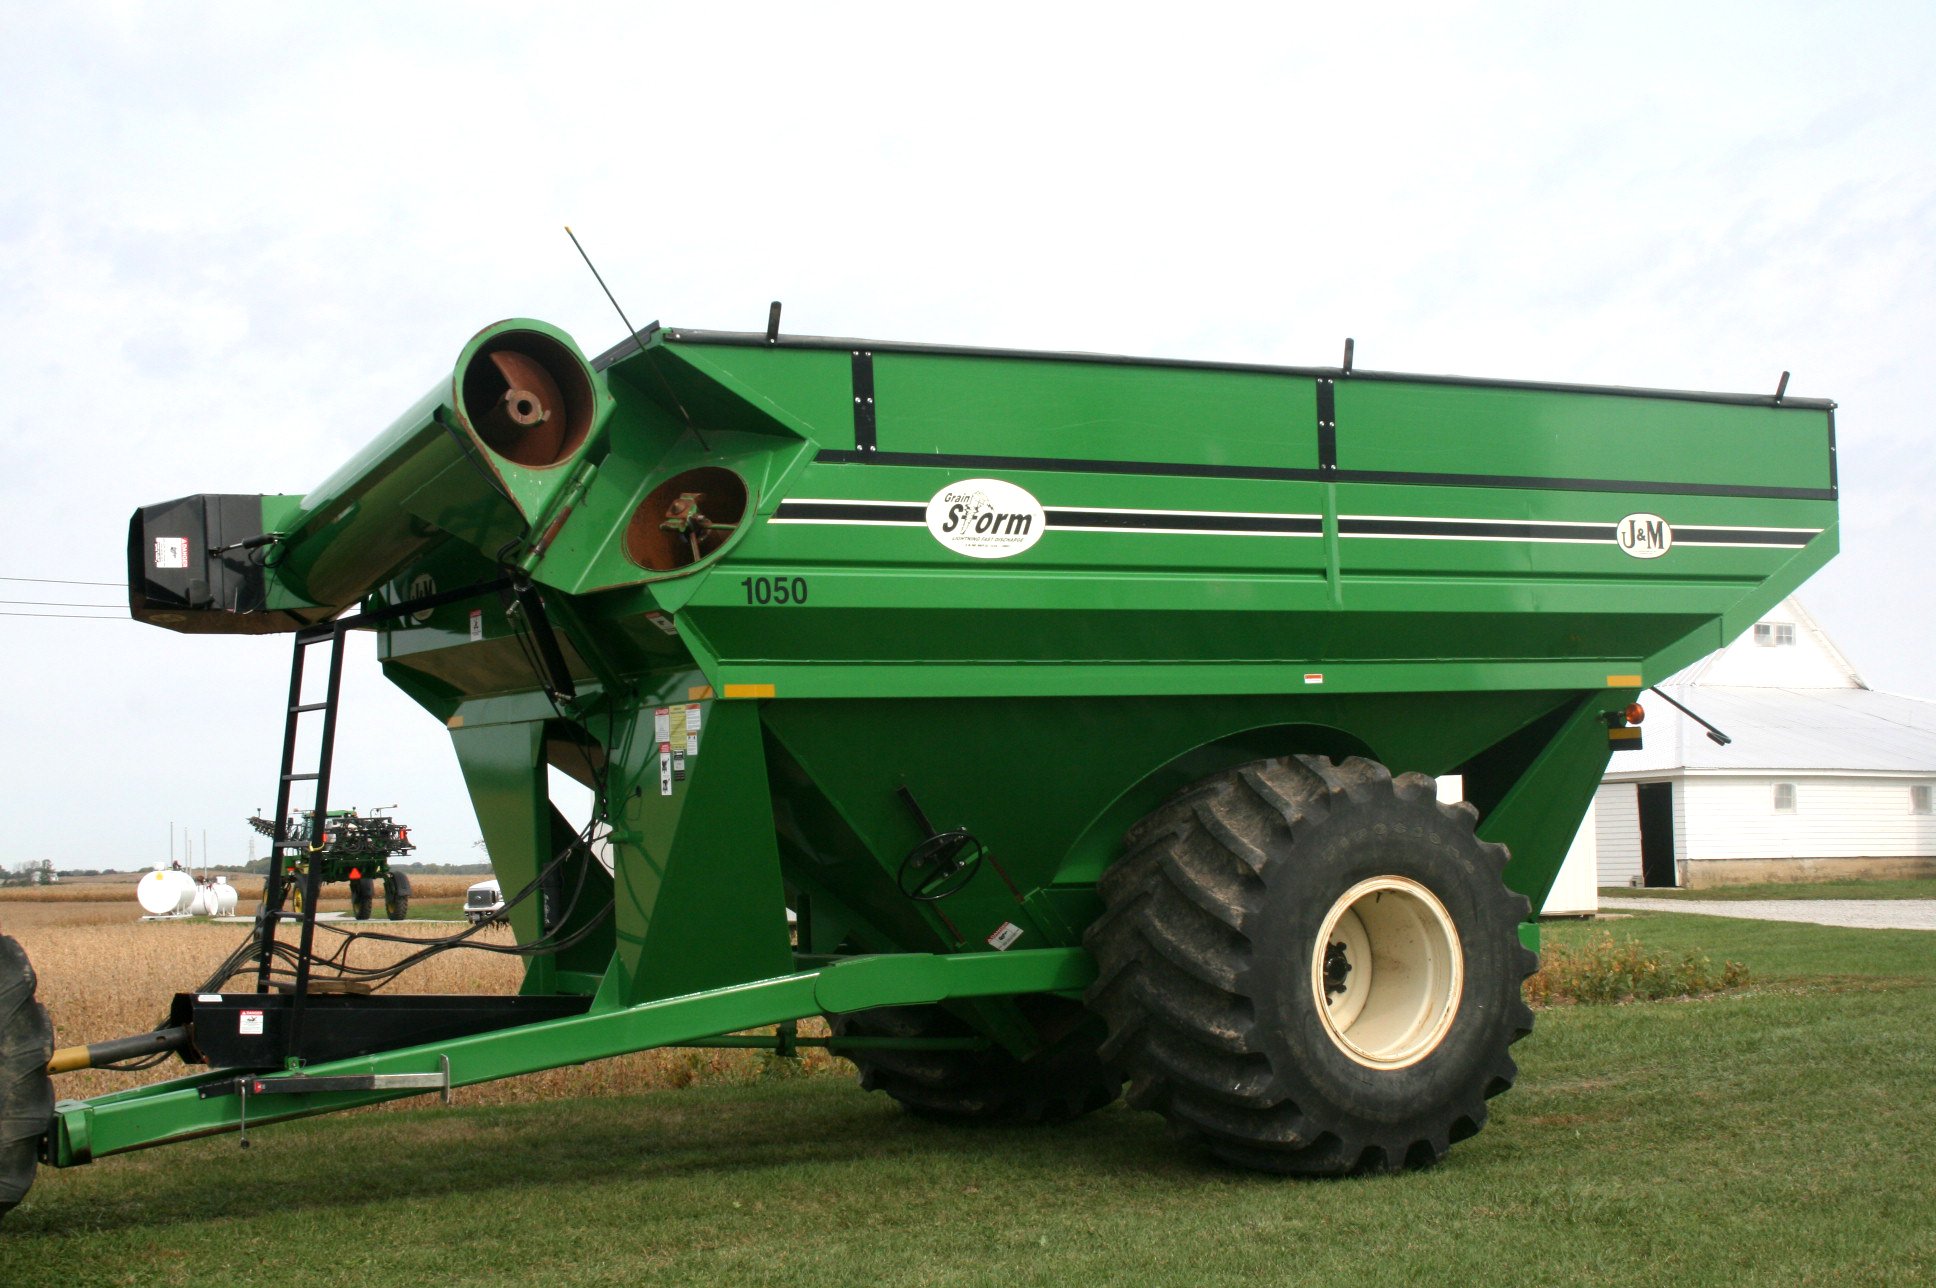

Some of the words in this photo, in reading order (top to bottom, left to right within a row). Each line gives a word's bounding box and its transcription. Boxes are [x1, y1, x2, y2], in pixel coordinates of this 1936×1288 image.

[944, 492, 970, 503] Grain
[942, 503, 1032, 535] Storm
[1621, 519, 1664, 549] J&M
[741, 576, 808, 605] 1050
